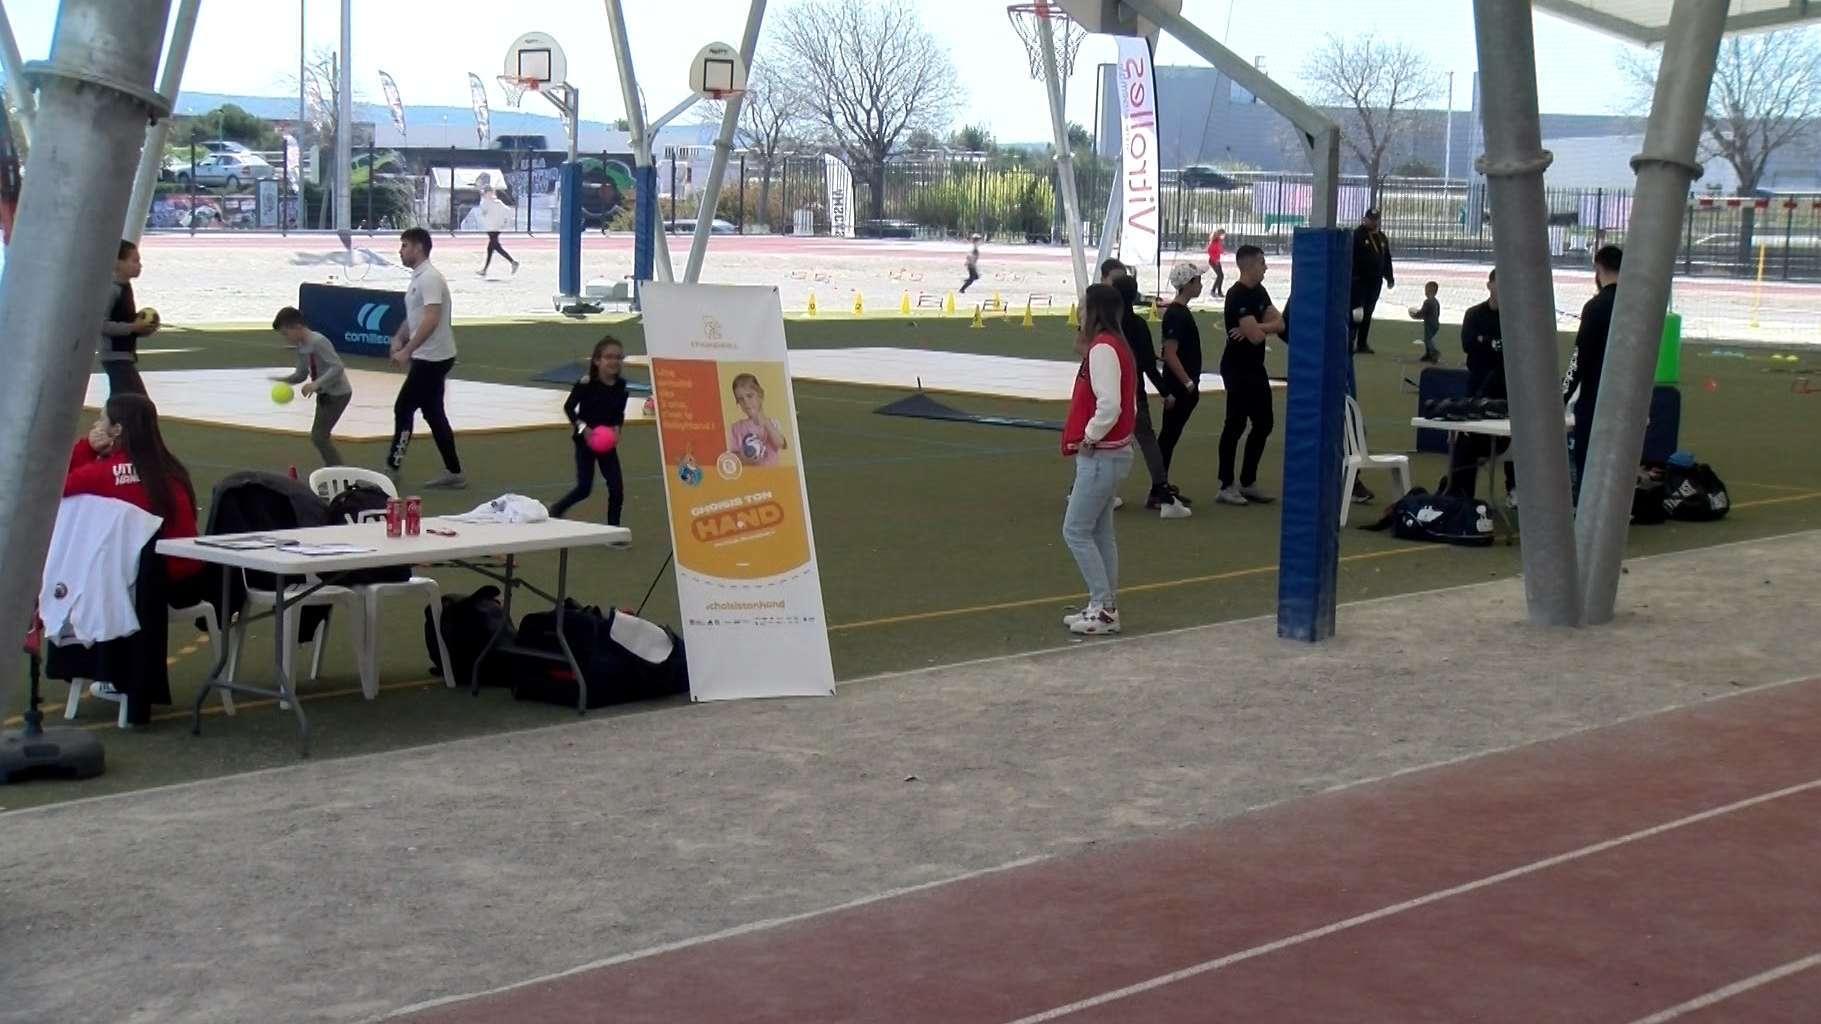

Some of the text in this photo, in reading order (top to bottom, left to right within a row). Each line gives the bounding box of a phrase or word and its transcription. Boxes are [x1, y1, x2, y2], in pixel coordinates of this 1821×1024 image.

[691, 491, 773, 516] CHOISIS TON
[695, 503, 780, 540] HAND
